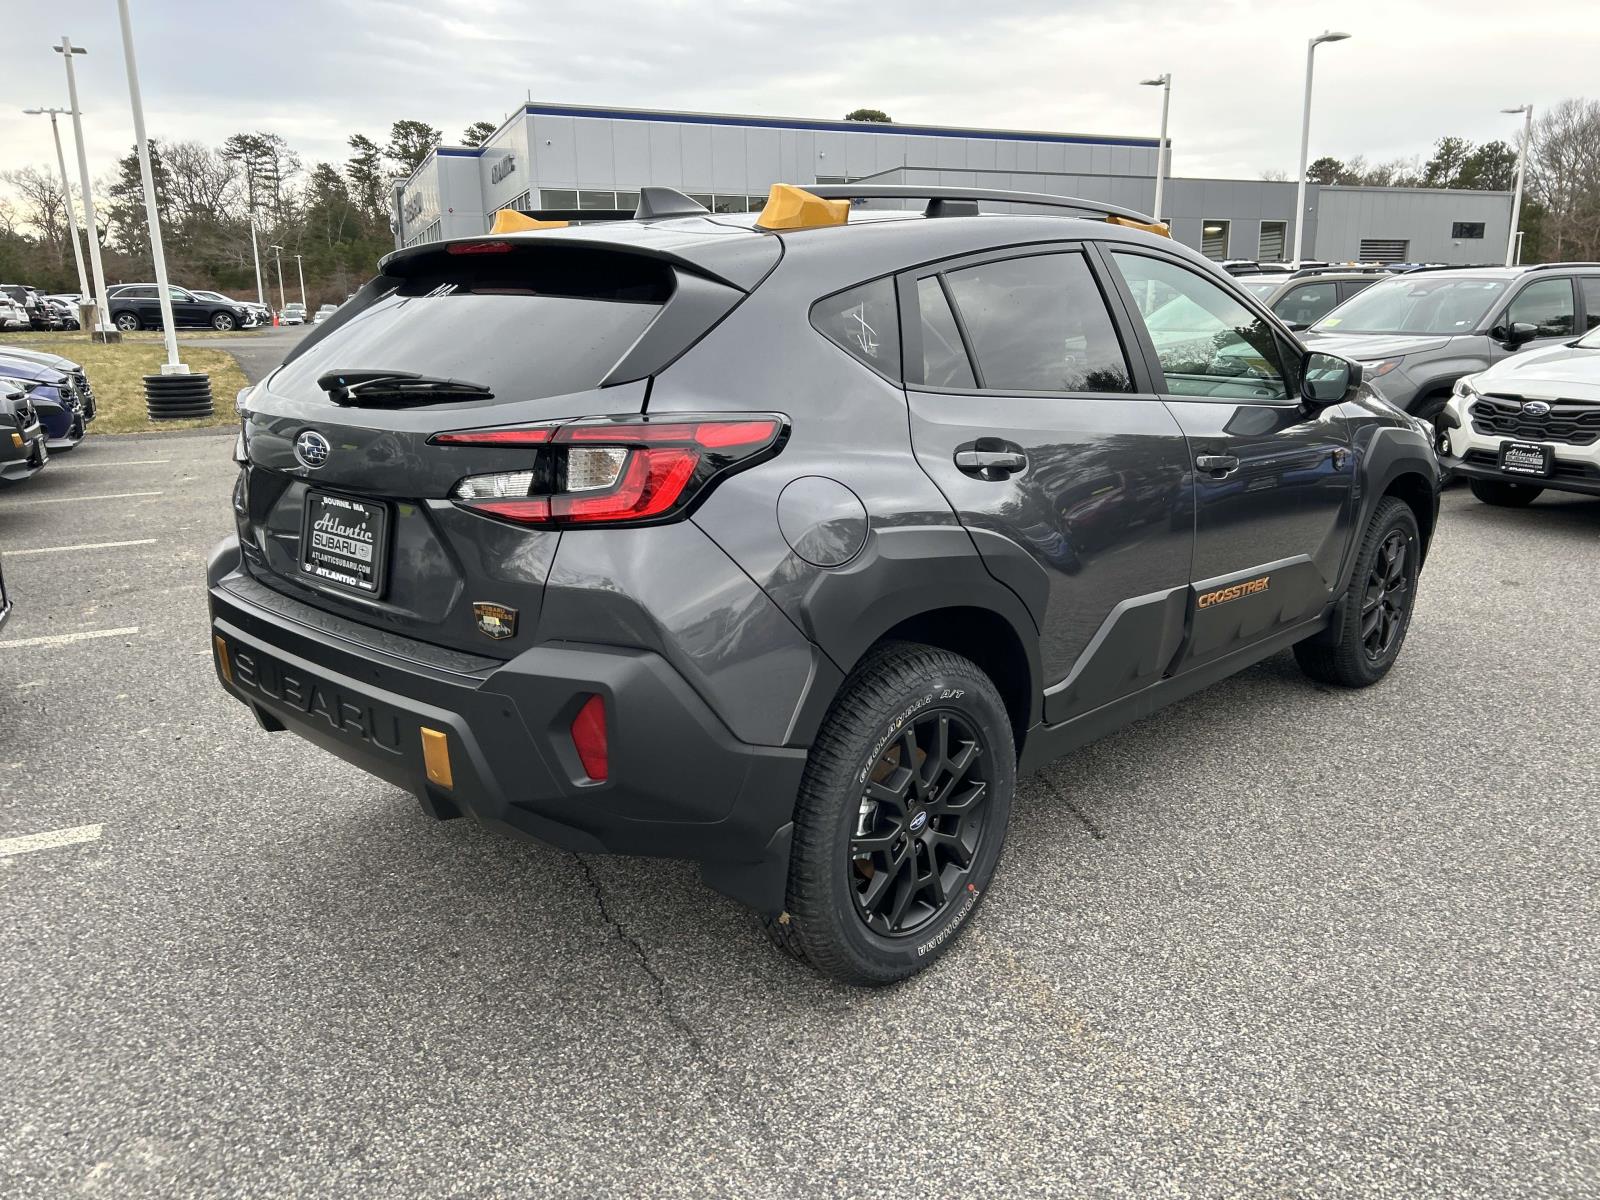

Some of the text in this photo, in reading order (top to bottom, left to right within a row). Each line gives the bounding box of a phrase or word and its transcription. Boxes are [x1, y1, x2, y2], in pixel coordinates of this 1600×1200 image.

[314, 512, 374, 543] Atlantic
[313, 533, 358, 556] SUBARU
[311, 551, 371, 574] ATLANTICSUBARU.COM
[315, 567, 357, 586] ATLANTIC
[1198, 576, 1270, 608] CROSSTREK
[235, 651, 404, 756] SUBARU
[939, 688, 966, 700] A/T
[917, 889, 980, 957] YOKOHAMA
